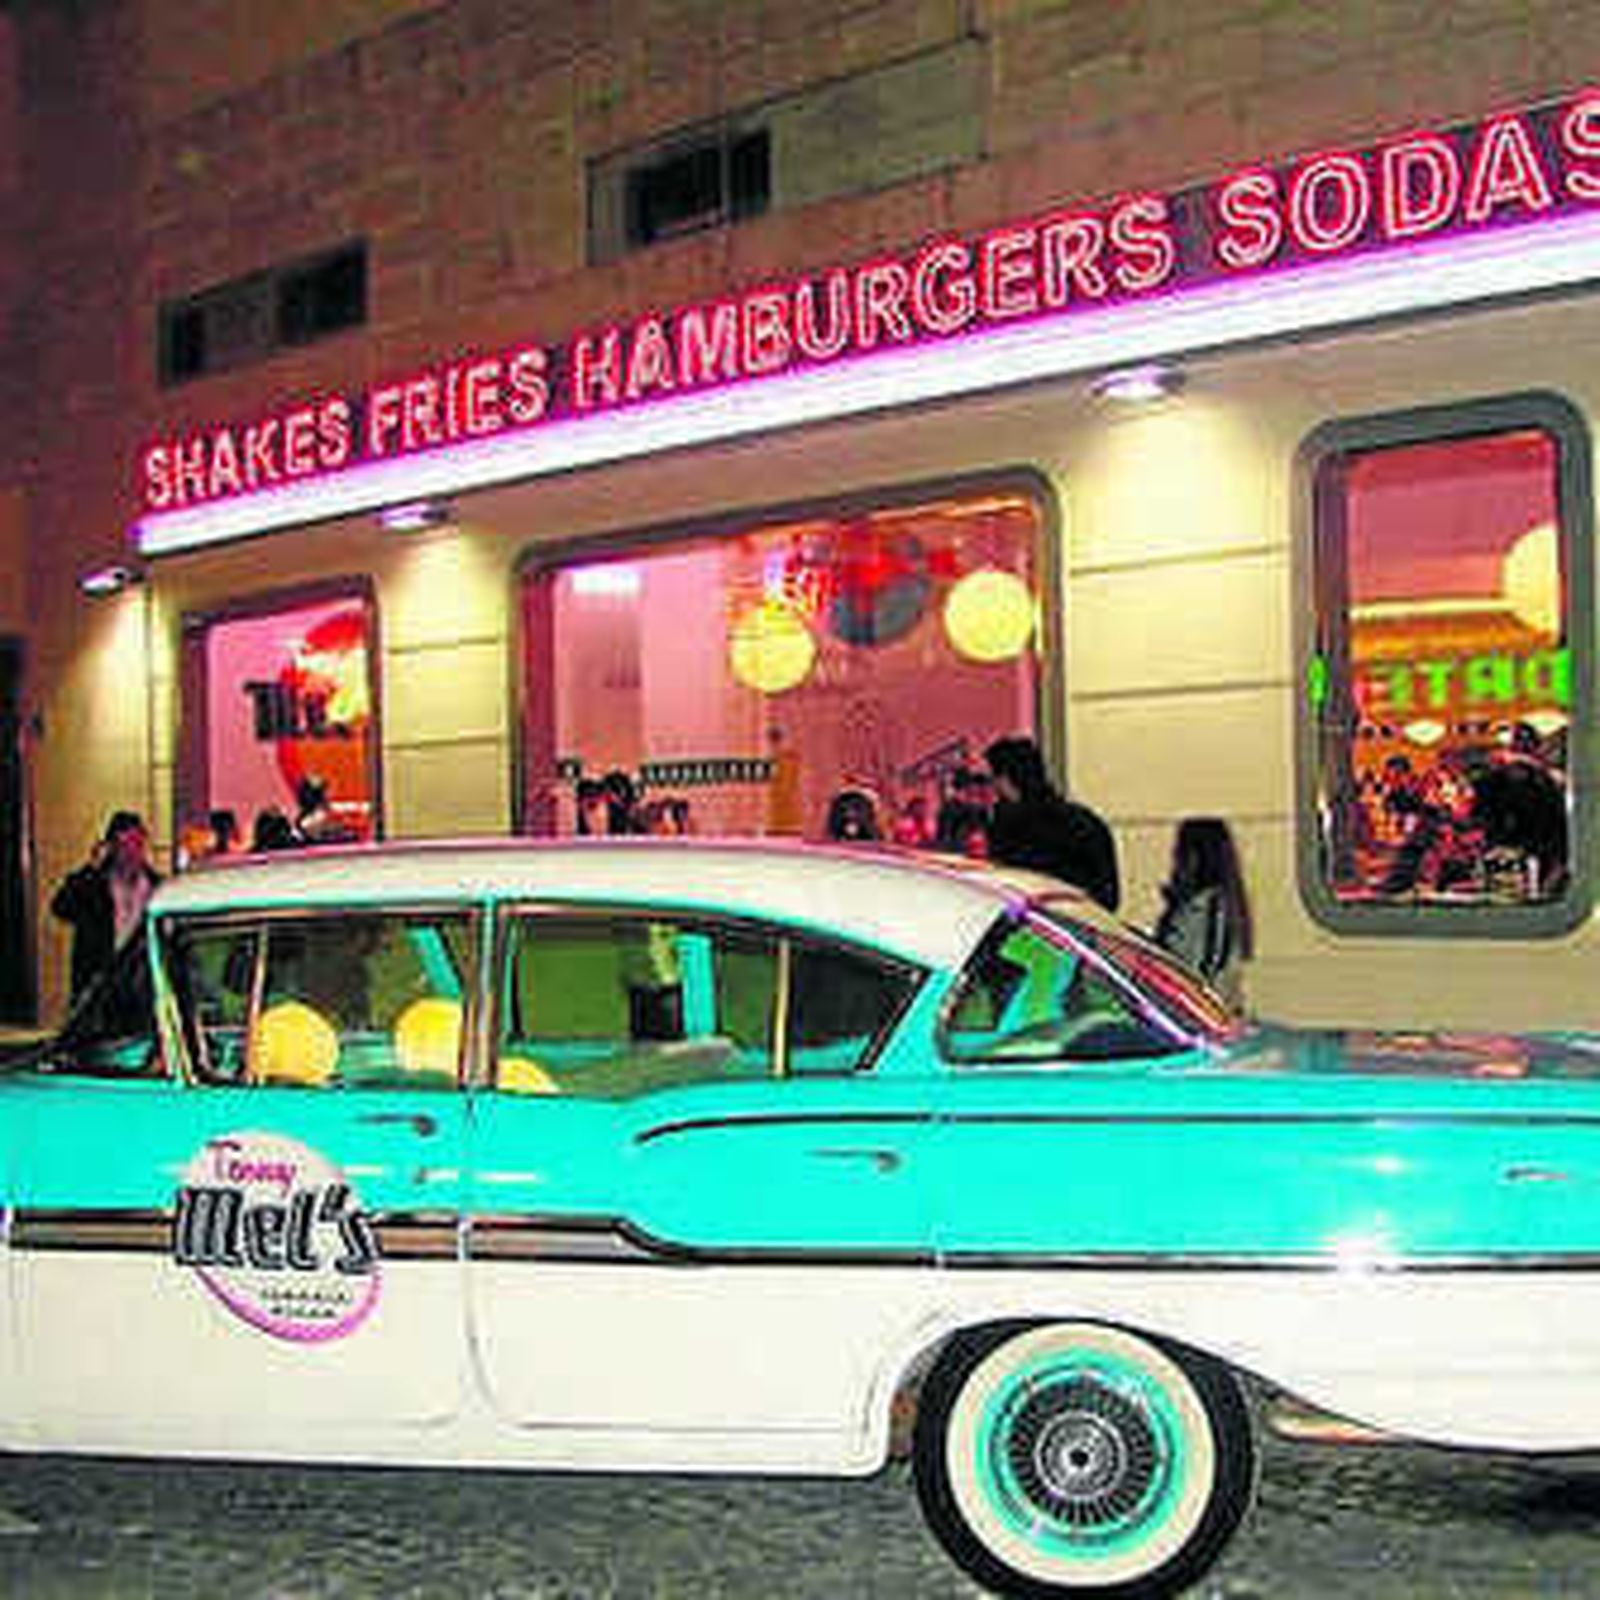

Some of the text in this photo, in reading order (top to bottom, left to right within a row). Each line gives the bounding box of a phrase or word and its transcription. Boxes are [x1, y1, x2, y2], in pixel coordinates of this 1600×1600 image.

[145, 97, 1600, 507] SHAKES FRIES HAMBURGERS SODAS
